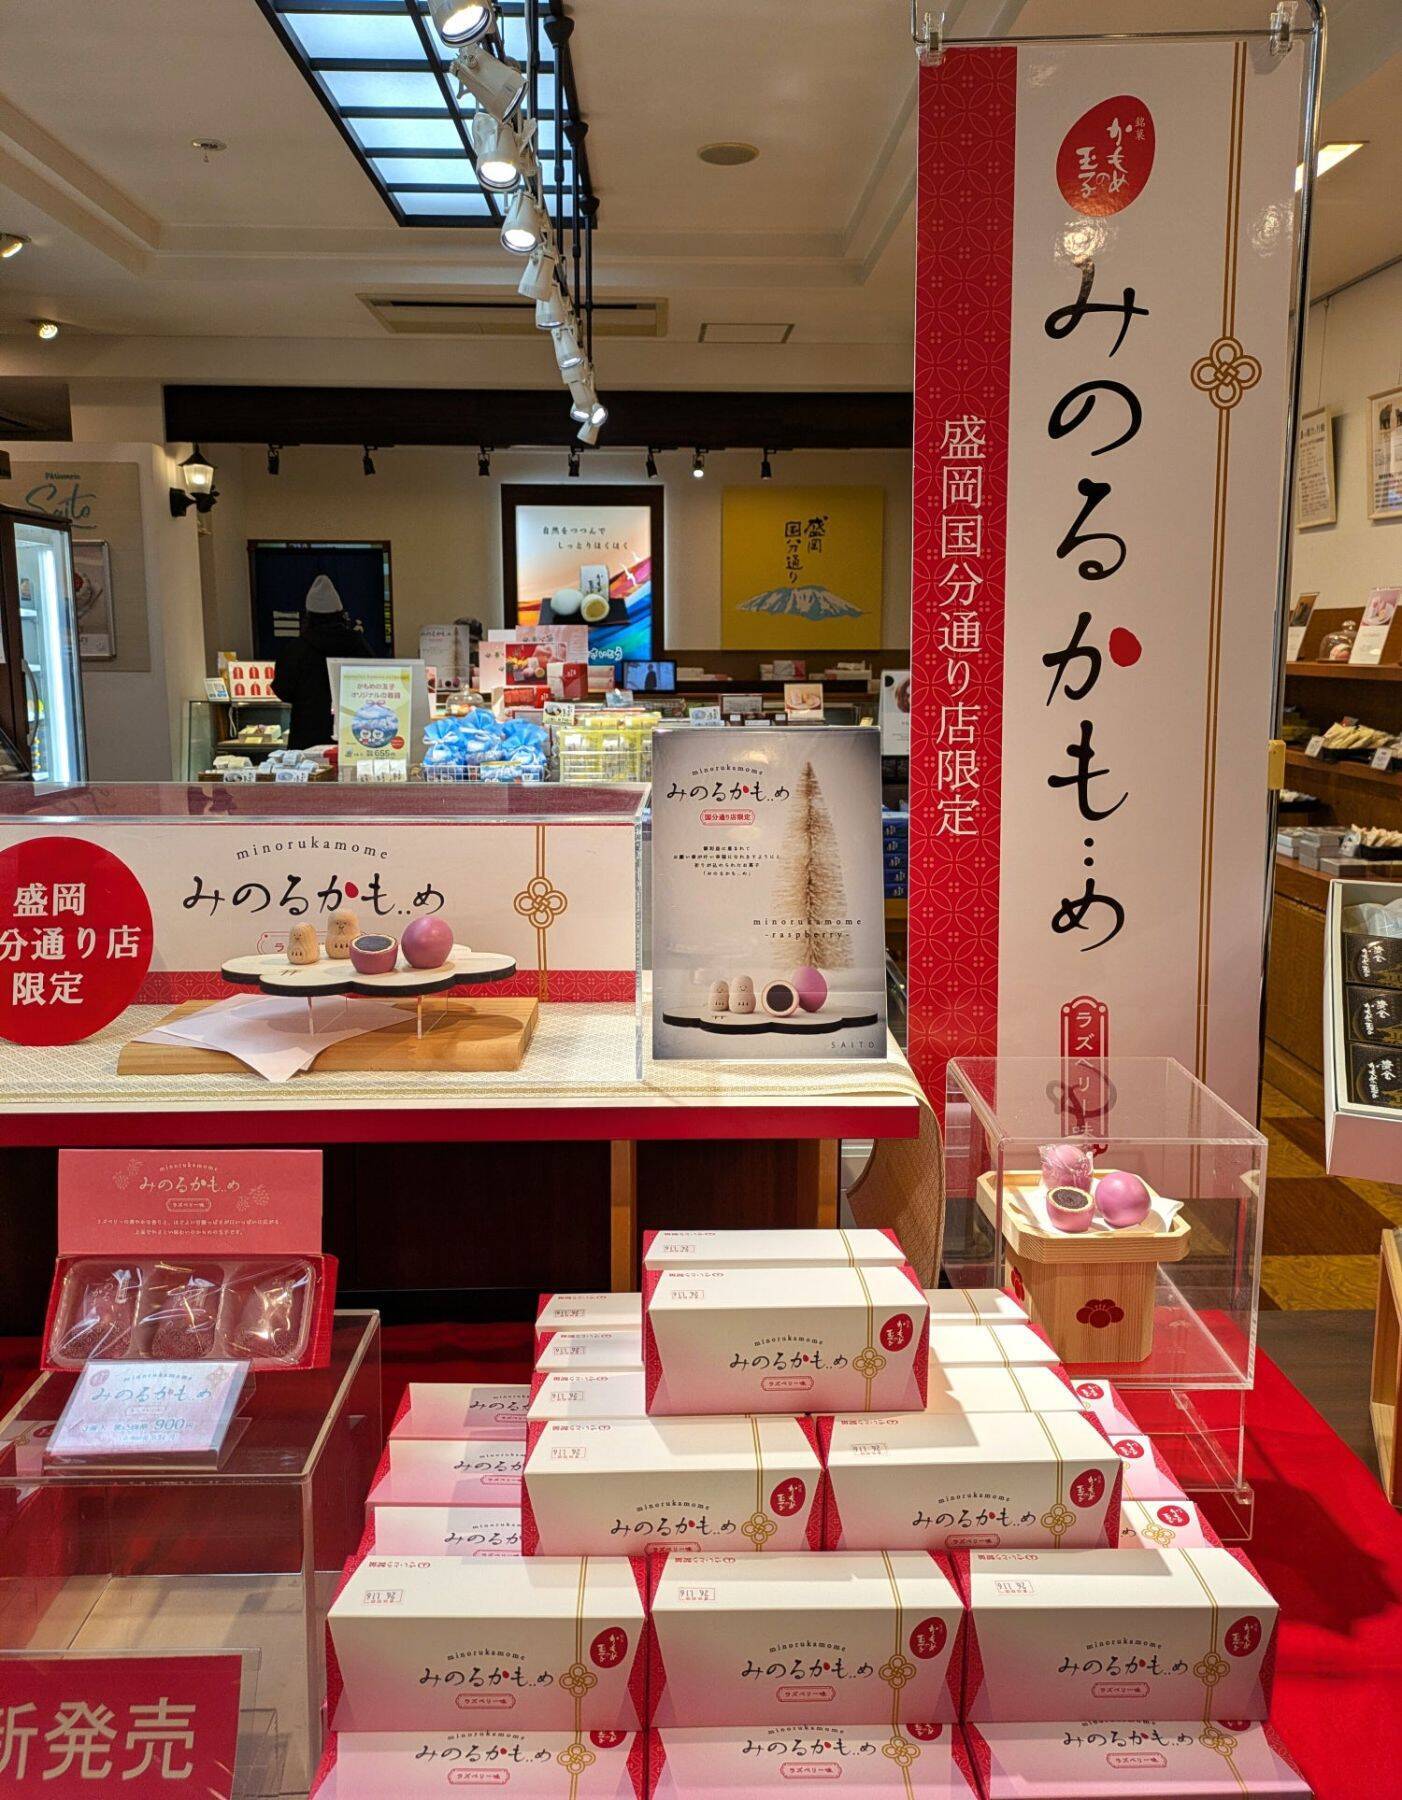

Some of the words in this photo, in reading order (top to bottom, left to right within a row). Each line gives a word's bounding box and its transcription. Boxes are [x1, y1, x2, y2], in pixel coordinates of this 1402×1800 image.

[542, 526, 607, 536] 自然をつつんで
[936, 414, 987, 837] 盛岡国分通り店限定
[692, 763, 764, 776] minorukamome
[236, 835, 390, 861] minorukamome
[12, 881, 87, 918] 盛岡
[752, 918, 863, 926] minorukamome
[12, 971, 85, 1006] 限定
[830, 1041, 876, 1049] SAITO
[753, 1333, 824, 1347] minorukamome
[937, 1491, 1012, 1504] minorukamome
[636, 1499, 710, 1512] minorukamome
[769, 1639, 847, 1653] minorukamome
[1086, 1637, 1163, 1650] minorukamome
[447, 1647, 527, 1661] minorukamome
